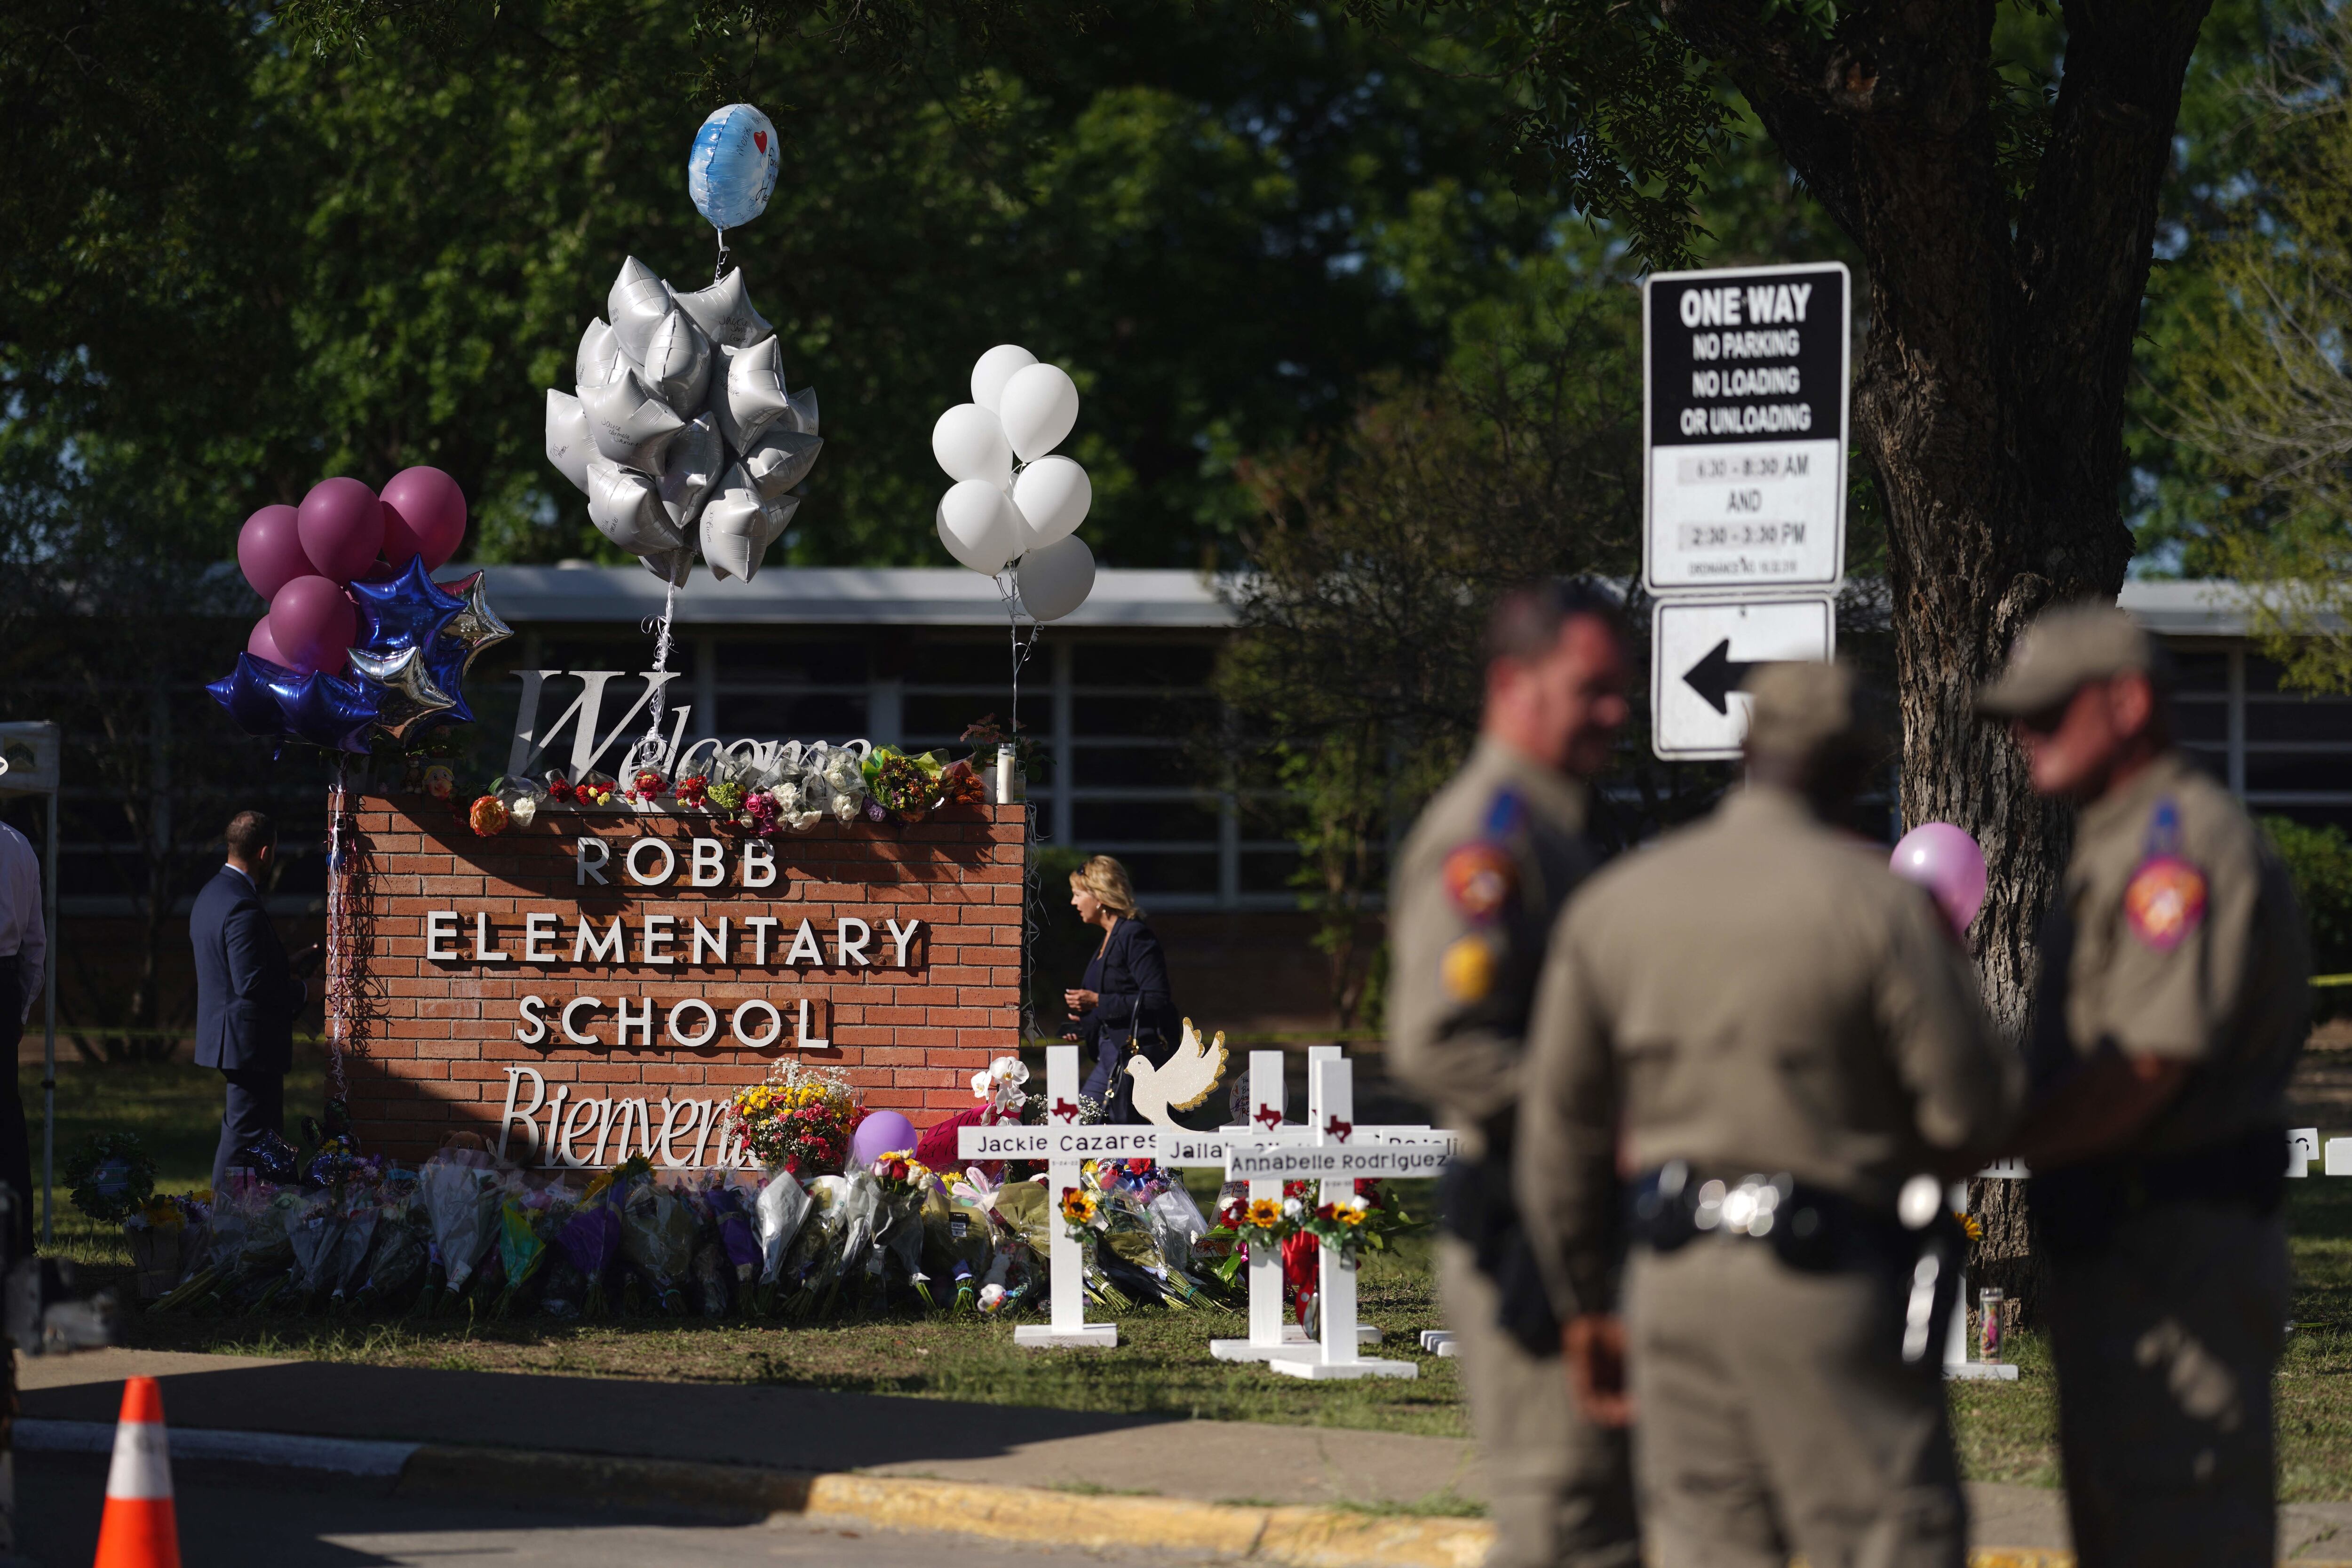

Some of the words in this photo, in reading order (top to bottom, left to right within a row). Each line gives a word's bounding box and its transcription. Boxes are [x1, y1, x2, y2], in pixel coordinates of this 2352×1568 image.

[1680, 287, 1741, 328] ONE
[1747, 283, 1812, 325] WAY
[1693, 332, 1720, 361] NO
[1722, 328, 1800, 359] PARKING
[1692, 369, 1720, 398] NO
[1721, 366, 1800, 397] LOADING
[1680, 407, 1708, 436] OR
[1709, 402, 1812, 435] UNLOADING
[1783, 452, 1810, 476] AM
[1725, 487, 1763, 513] AND
[1781, 519, 1807, 545] PM
[577, 837, 777, 888] ROBB
[427, 911, 919, 967] ELEMENTARY
[516, 995, 829, 1049] SCHOOL
[978, 1136, 1048, 1152] Jackie
[1060, 1134, 1157, 1151] Cazares
[1232, 1153, 1335, 1172] Annabelle
[1343, 1153, 1448, 1171] Rodriguez
